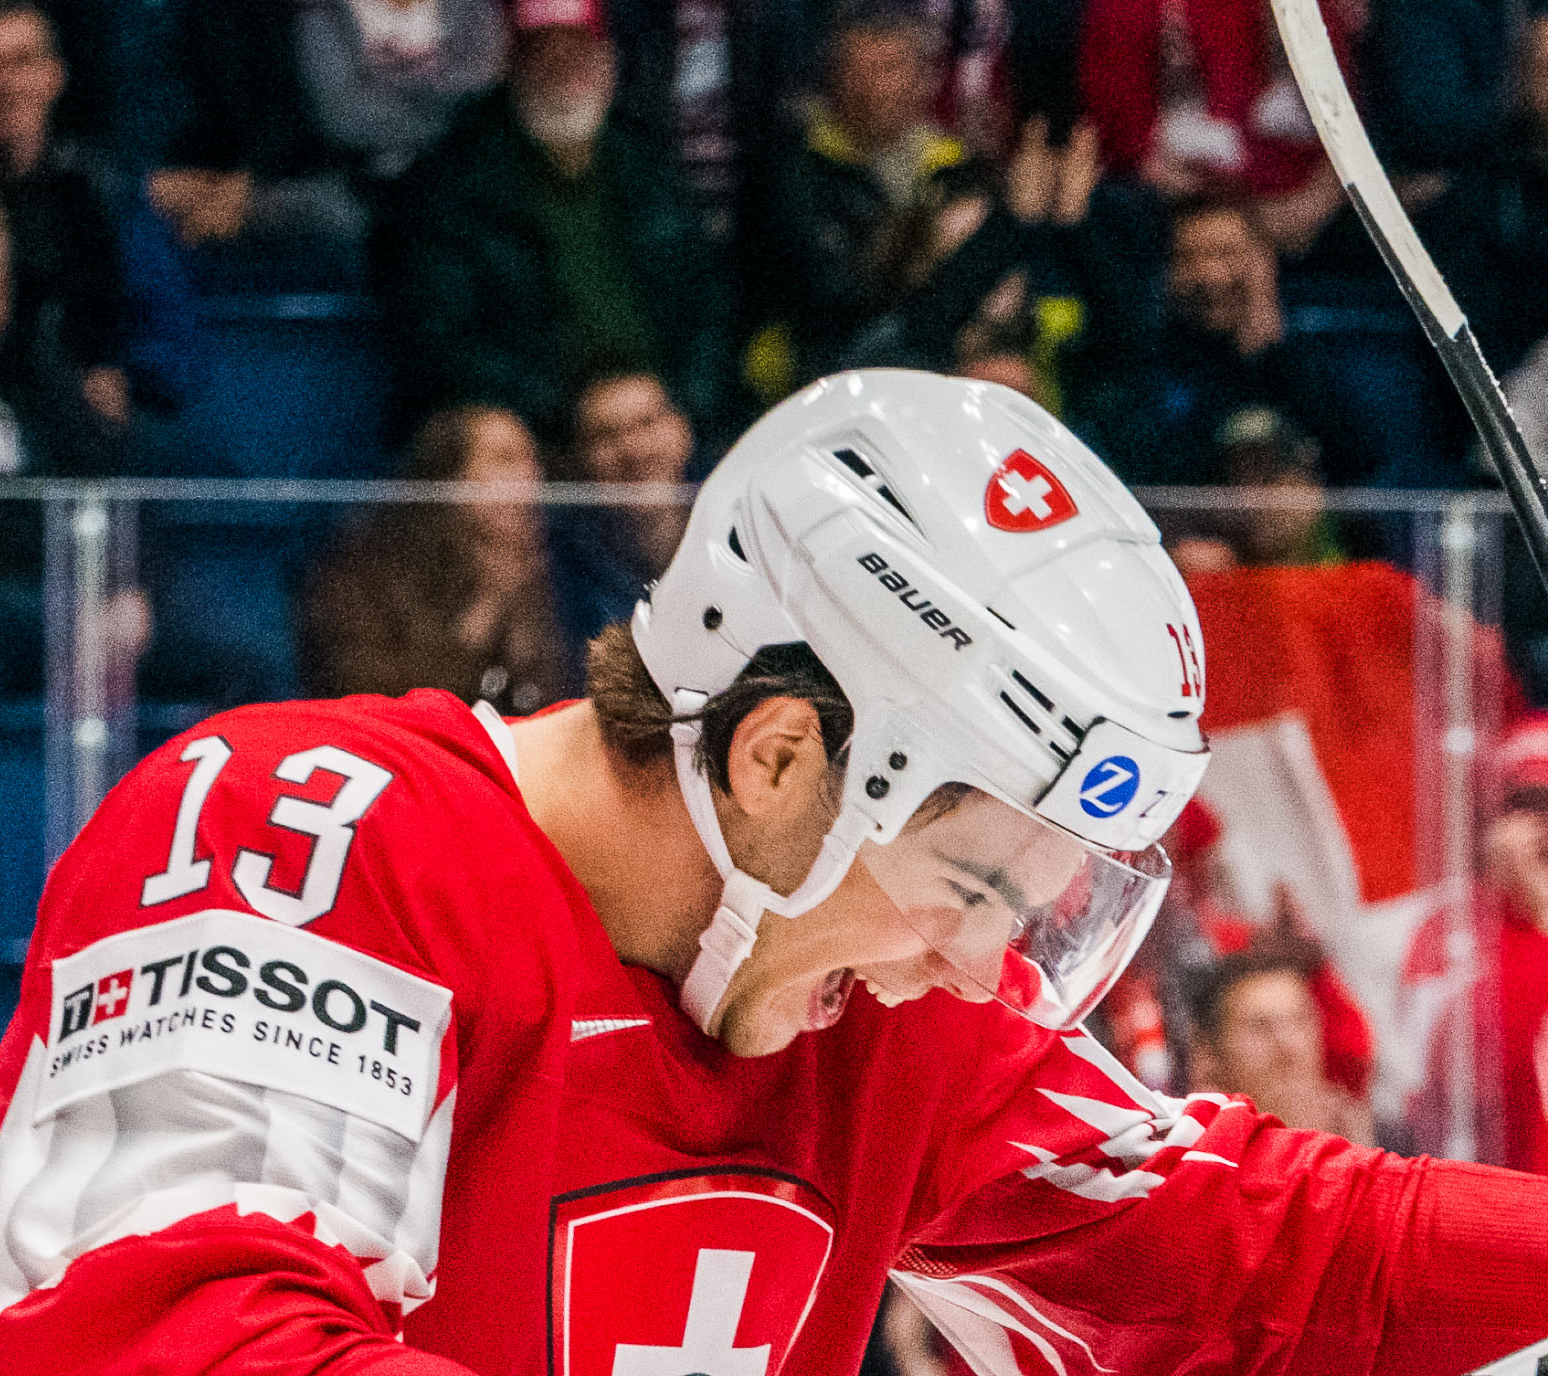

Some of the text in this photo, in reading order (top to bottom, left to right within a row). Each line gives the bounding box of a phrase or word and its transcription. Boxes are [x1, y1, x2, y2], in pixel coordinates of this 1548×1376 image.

[857, 552, 973, 651] BAUER
[139, 735, 394, 928] 13
[49, 1009, 414, 1096] SWISS WATCHES SINCE 1853
[141, 945, 421, 1057] TISSOT
